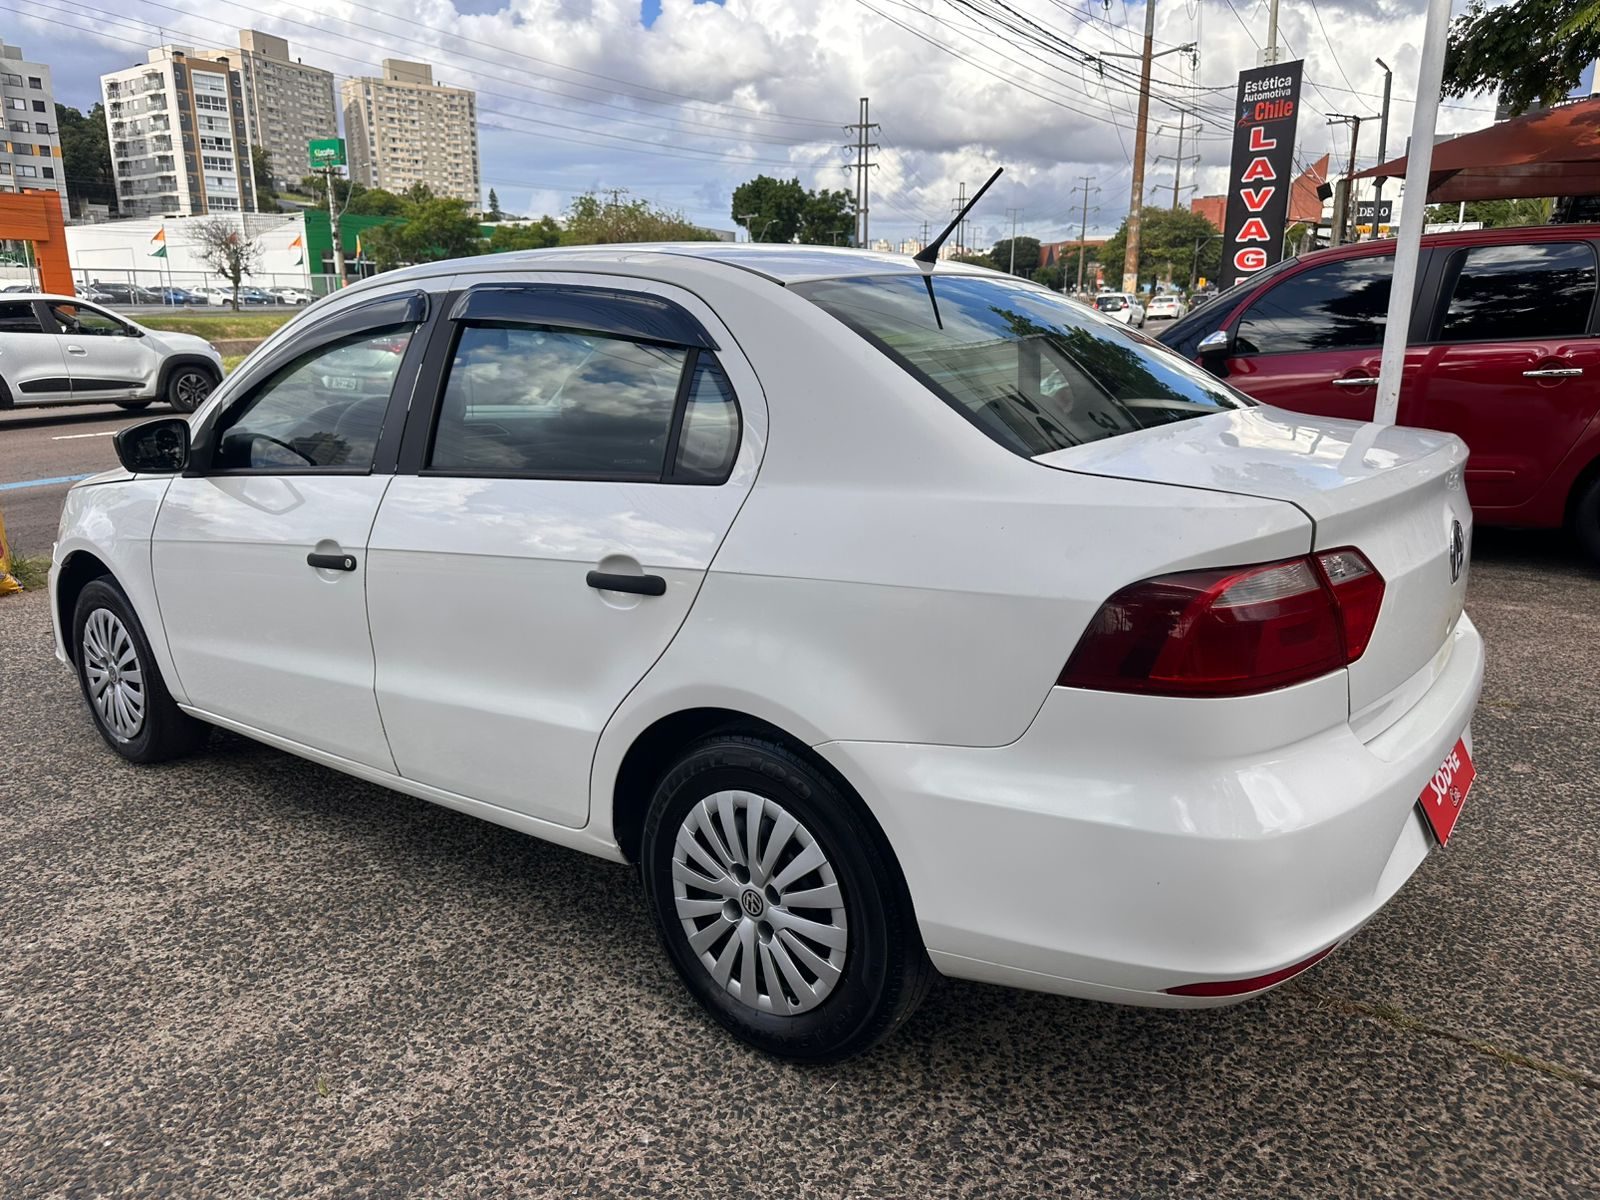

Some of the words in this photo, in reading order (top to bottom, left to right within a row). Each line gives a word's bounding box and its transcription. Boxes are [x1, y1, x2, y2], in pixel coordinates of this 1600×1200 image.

[1245, 76, 1292, 94] Estética
[1243, 88, 1291, 102] Automotiva
[1254, 99, 1293, 120] Chile
[1234, 126, 1277, 286] LAVAG
